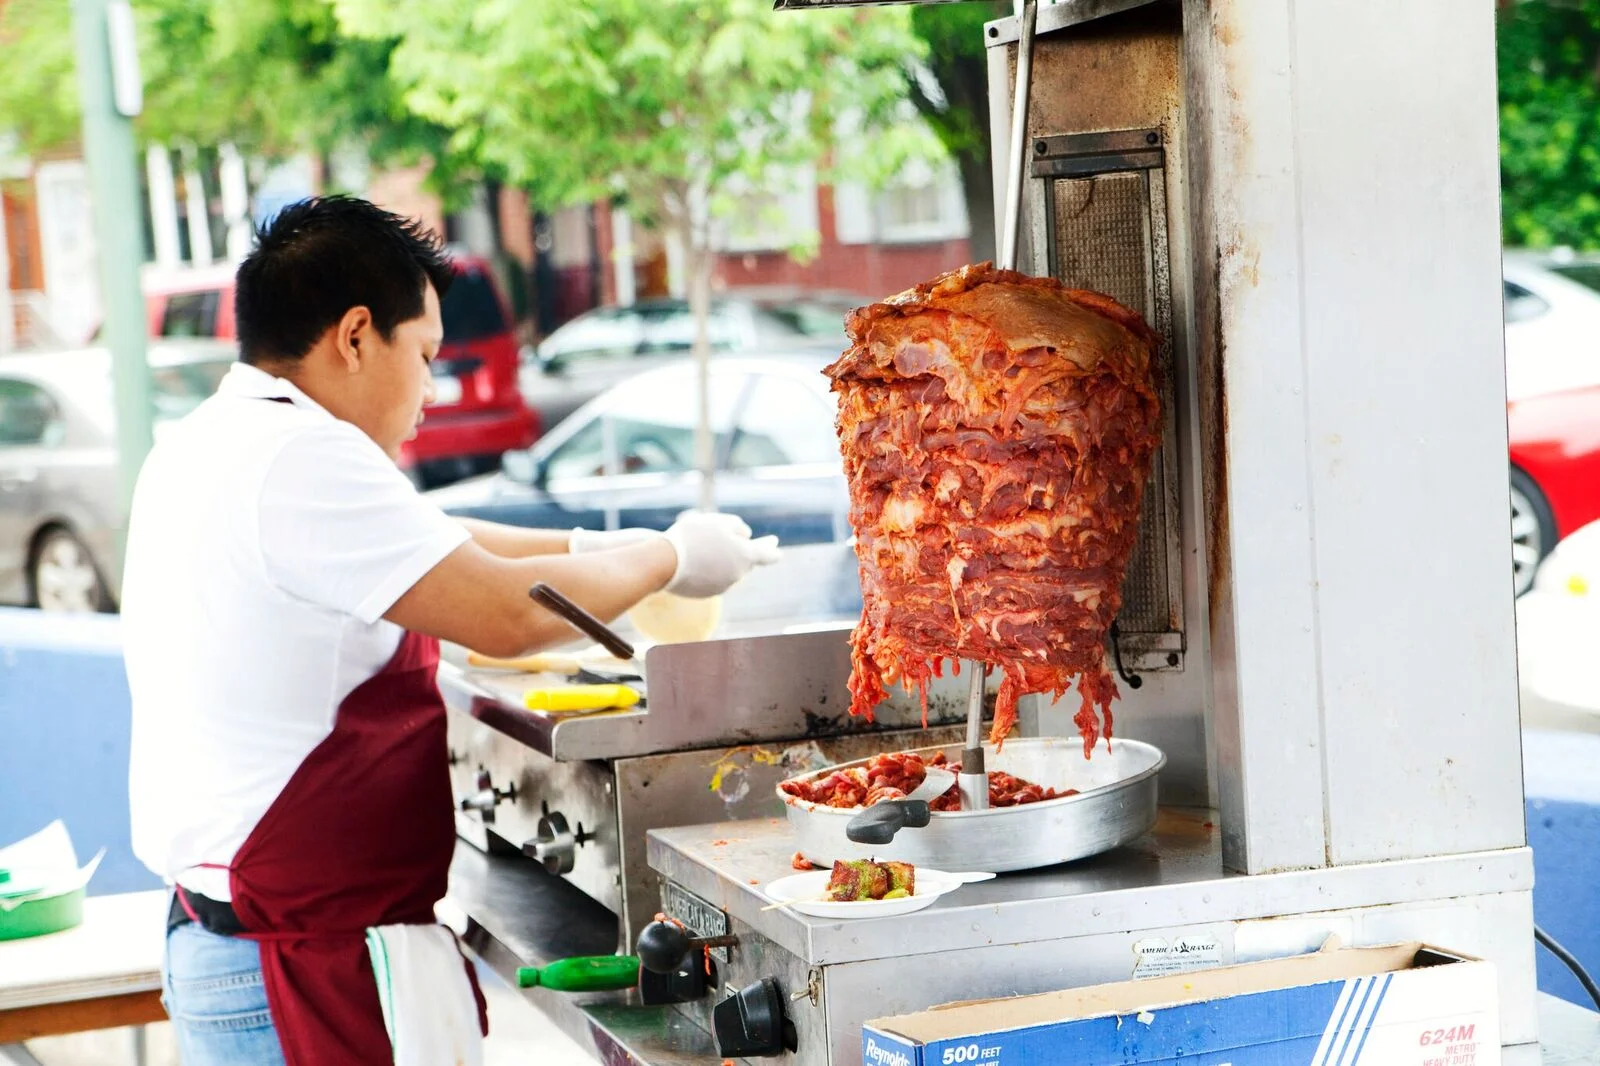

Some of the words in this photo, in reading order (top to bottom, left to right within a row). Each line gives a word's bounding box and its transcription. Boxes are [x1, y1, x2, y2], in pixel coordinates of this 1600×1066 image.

[1419, 1023, 1475, 1046] 624M
[865, 1037, 911, 1066] Reynolds
[942, 1044, 979, 1065] 500
[980, 1046, 1002, 1060] FEET
[1423, 1056, 1451, 1066] HEAVY
[1452, 1053, 1477, 1065] DUTY
[1445, 1043, 1476, 1055] METRO
